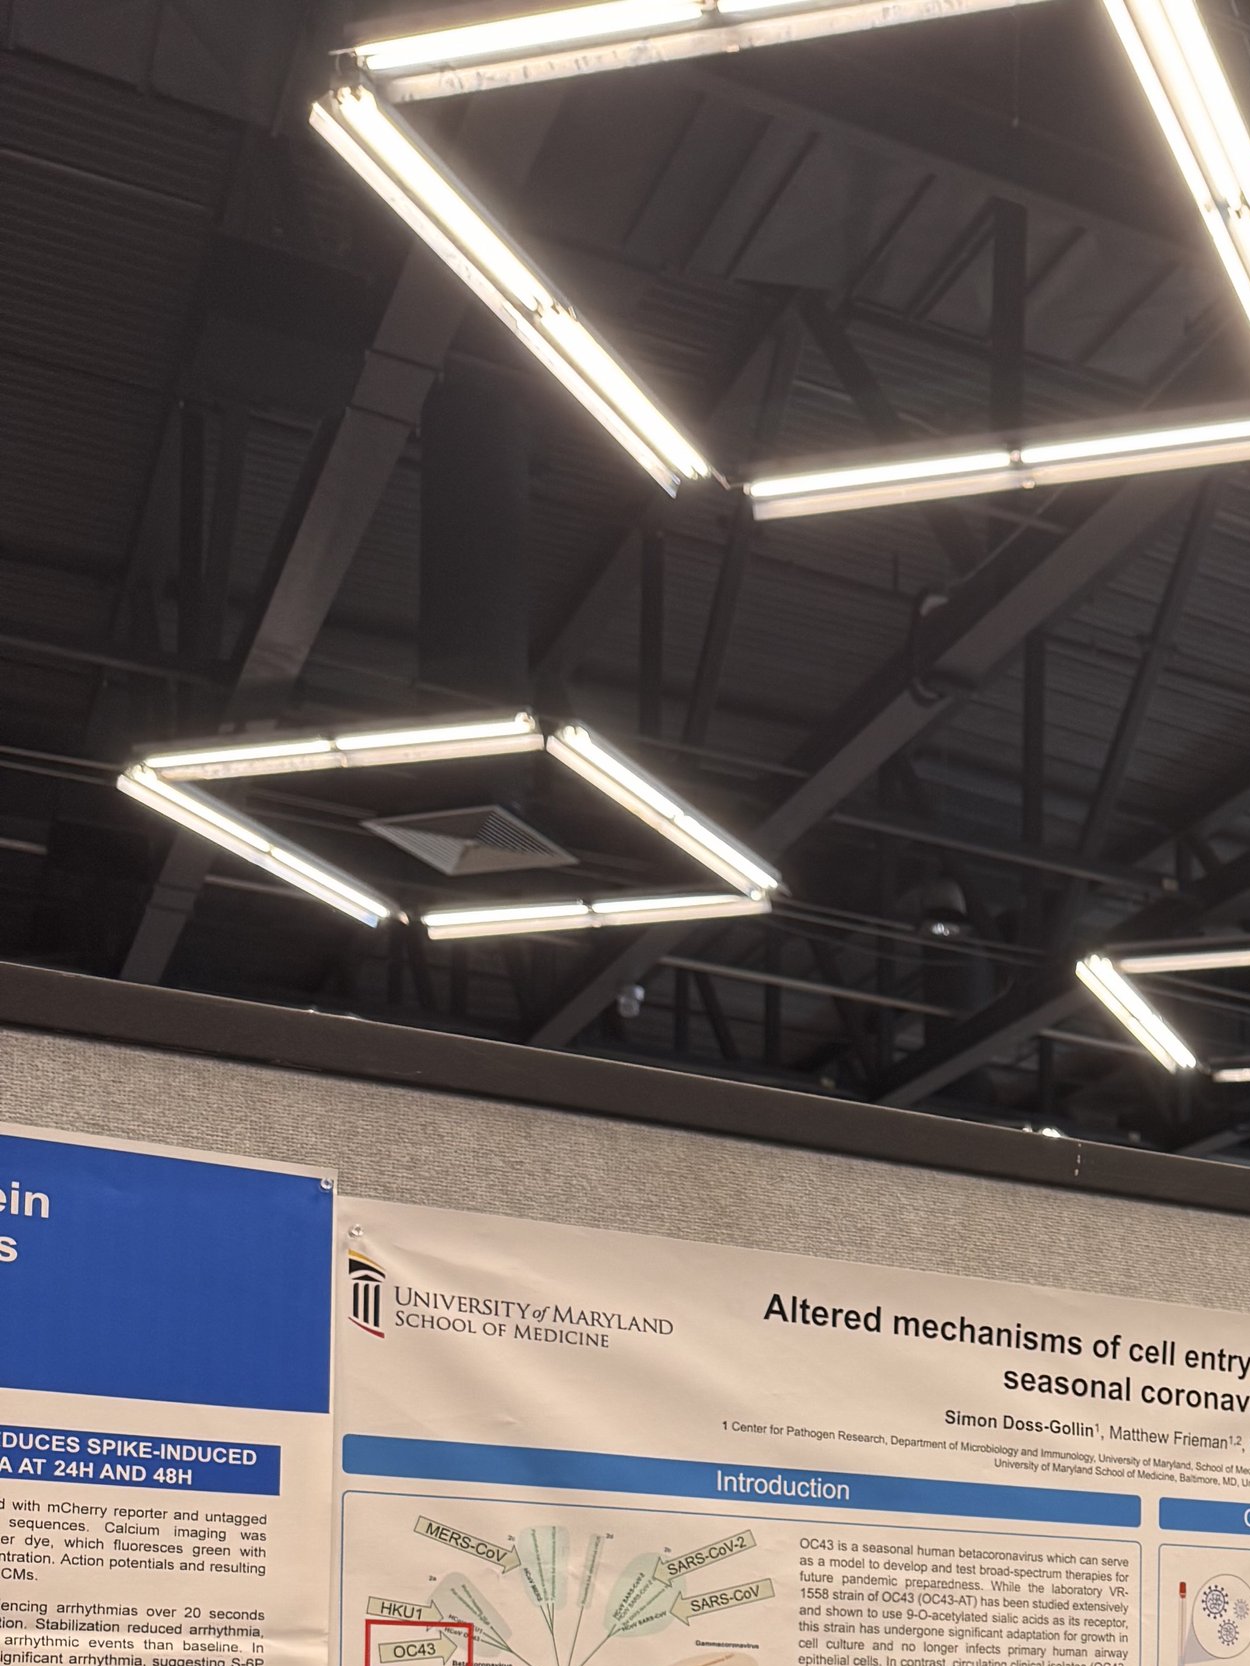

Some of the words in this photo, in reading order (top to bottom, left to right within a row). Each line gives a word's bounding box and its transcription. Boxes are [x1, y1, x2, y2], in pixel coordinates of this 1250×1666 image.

[395, 1286, 531, 1319] UNIVERSITY
[532, 1306, 550, 1323] of
[552, 1304, 673, 1335] MARYLAND
[394, 1310, 477, 1334] SCHOOL
[482, 1321, 506, 1336] OF
[513, 1323, 608, 1348] MEDICINE
[763, 1293, 881, 1332] Altered
[893, 1315, 1082, 1355] mechanisms
[1092, 1334, 1122, 1359] of
[1128, 1340, 1175, 1366] cell
[1003, 1370, 1130, 1401] seasonal
[944, 1409, 997, 1428] Simon
[1109, 1424, 1169, 1444] Matthew
[0, 1431, 80, 1453] DUCES
[86, 1438, 256, 1465] SPIKE-INDUCED
[17, 1457, 46, 1475] AT
[53, 1459, 93, 1478] 24H
[99, 1463, 146, 1481] AND
[152, 1467, 191, 1484] 48H
[717, 1469, 849, 1500] Introduction
[12, 1499, 40, 1512] with
[47, 1501, 107, 1518] mCherry
[113, 1507, 168, 1520] reporter
[173, 1510, 198, 1521] and
[205, 1512, 267, 1526] untagged
[424, 1522, 508, 1564] MERS-CoV
[666, 1535, 748, 1577] SARS-CoV-2
[799, 1537, 834, 1551] OC43
[837, 1539, 848, 1551] is
[850, 1543, 858, 1552] a
[862, 1543, 913, 1555] seasonal
[917, 1544, 955, 1557] human
[958, 1547, 1044, 1562] betacoronavirus
[1046, 1552, 1076, 1564] which
[1079, 1556, 1098, 1565] can
[1100, 1557, 1129, 1567] serve
[379, 1601, 423, 1620] HKU1
[690, 1585, 760, 1612] SARS-CoV
[393, 1642, 437, 1659] OC43
